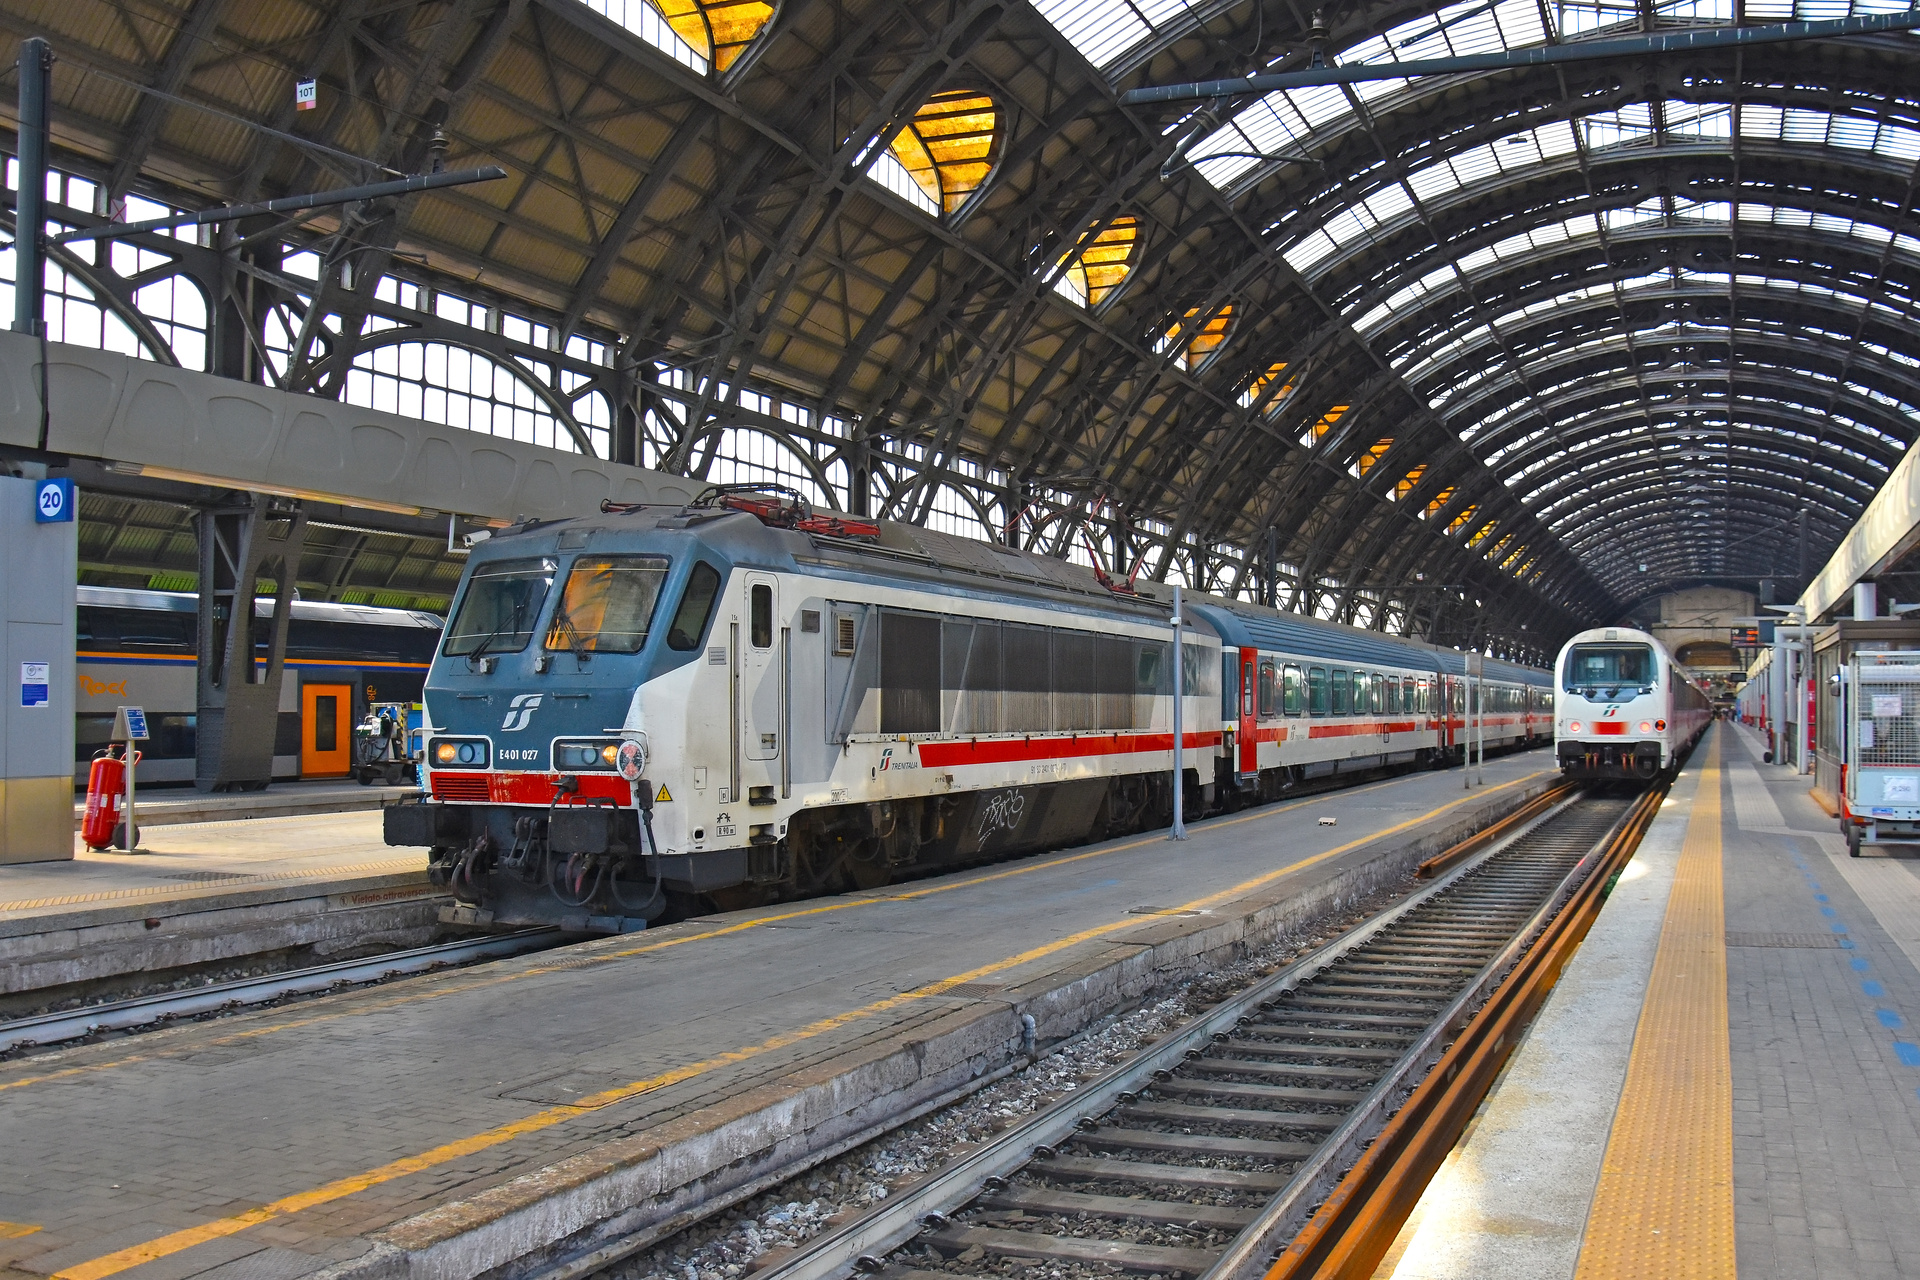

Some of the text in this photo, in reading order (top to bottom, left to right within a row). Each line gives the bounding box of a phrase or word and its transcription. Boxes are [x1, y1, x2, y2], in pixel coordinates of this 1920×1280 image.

[299, 86, 314, 98] 10T
[42, 491, 61, 509] 20
[79, 675, 127, 697] Rock
[499, 749, 538, 760] E401 027
[891, 761, 918, 771] TRENITALIA
[351, 893, 382, 905] Vietato
